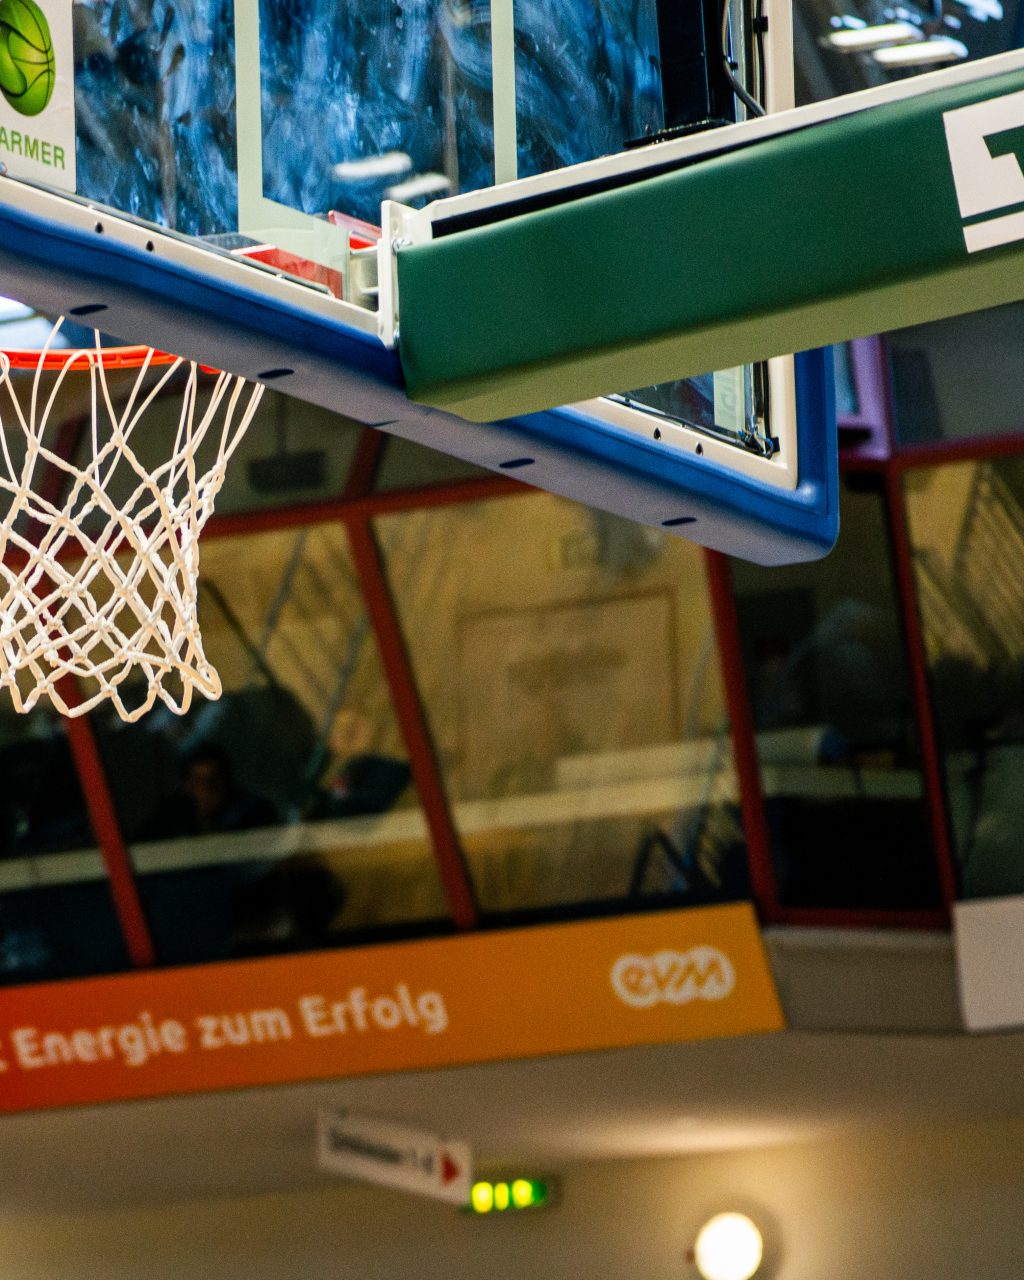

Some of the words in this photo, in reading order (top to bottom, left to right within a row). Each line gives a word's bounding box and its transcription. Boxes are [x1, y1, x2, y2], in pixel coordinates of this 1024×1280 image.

[12, 1012, 189, 1069] Energie
[196, 1008, 293, 1049] zum
[299, 982, 449, 1036] Erfolg
